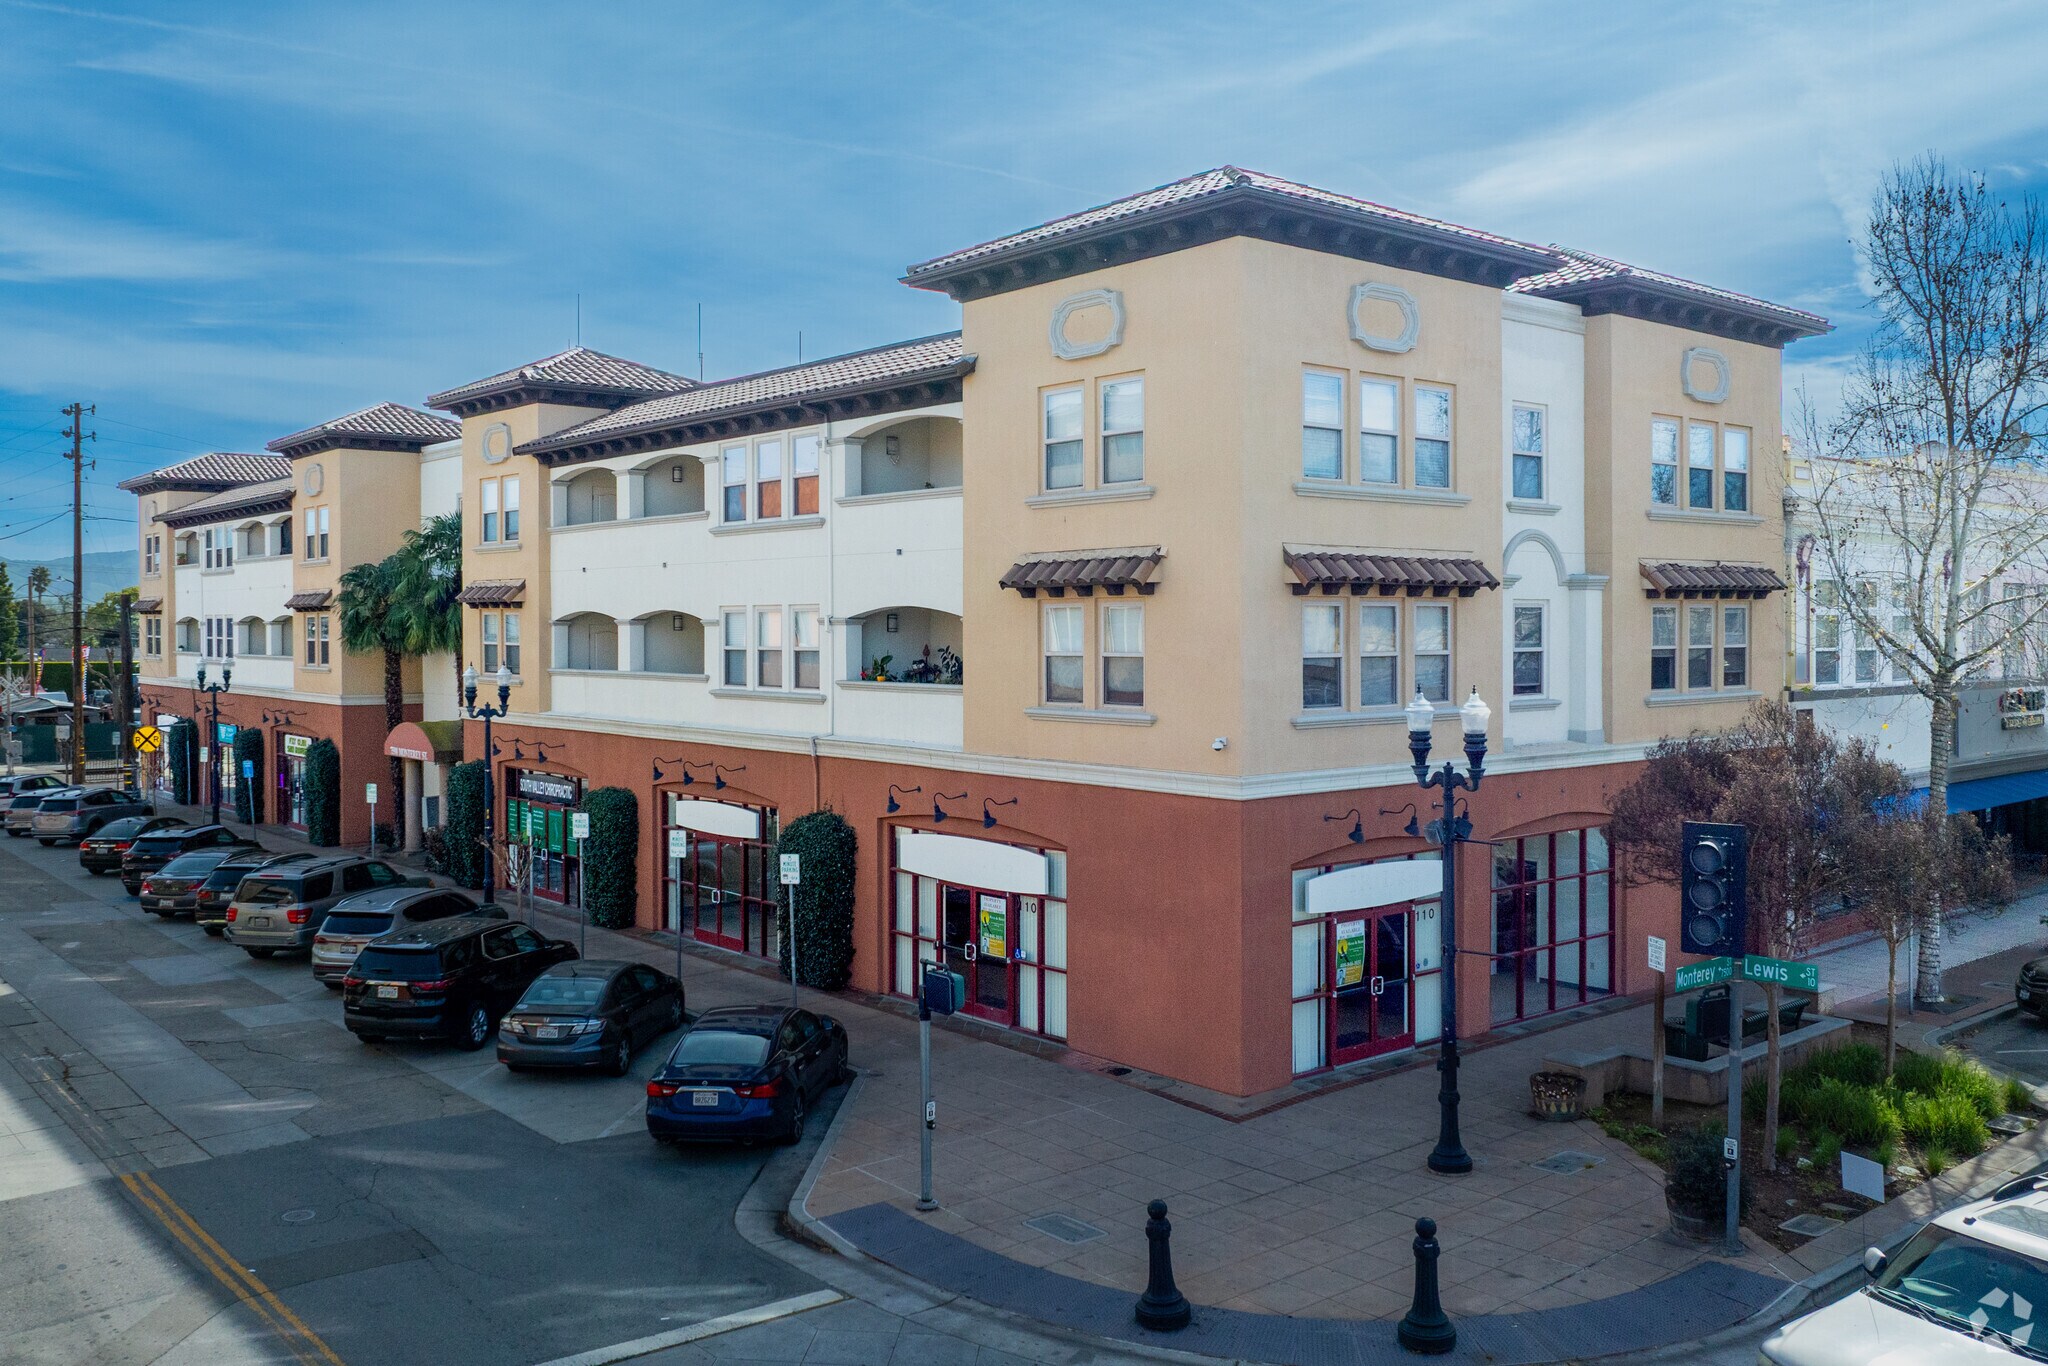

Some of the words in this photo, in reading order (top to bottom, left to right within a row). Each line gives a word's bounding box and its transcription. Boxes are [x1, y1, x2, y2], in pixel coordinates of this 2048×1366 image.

[520, 779, 532, 792] SOUTH
[532, 780, 545, 794] VALLEY
[545, 782, 573, 799] CHIROPRACTIC
[1415, 908, 1435, 921] 110
[1726, 957, 1732, 967] ST
[1721, 966, 1733, 977] 7500
[1744, 958, 1788, 981] Lewis
[1805, 967, 1816, 978] ST
[1676, 966, 1716, 989] Monterey
[1807, 978, 1816, 987] 10
